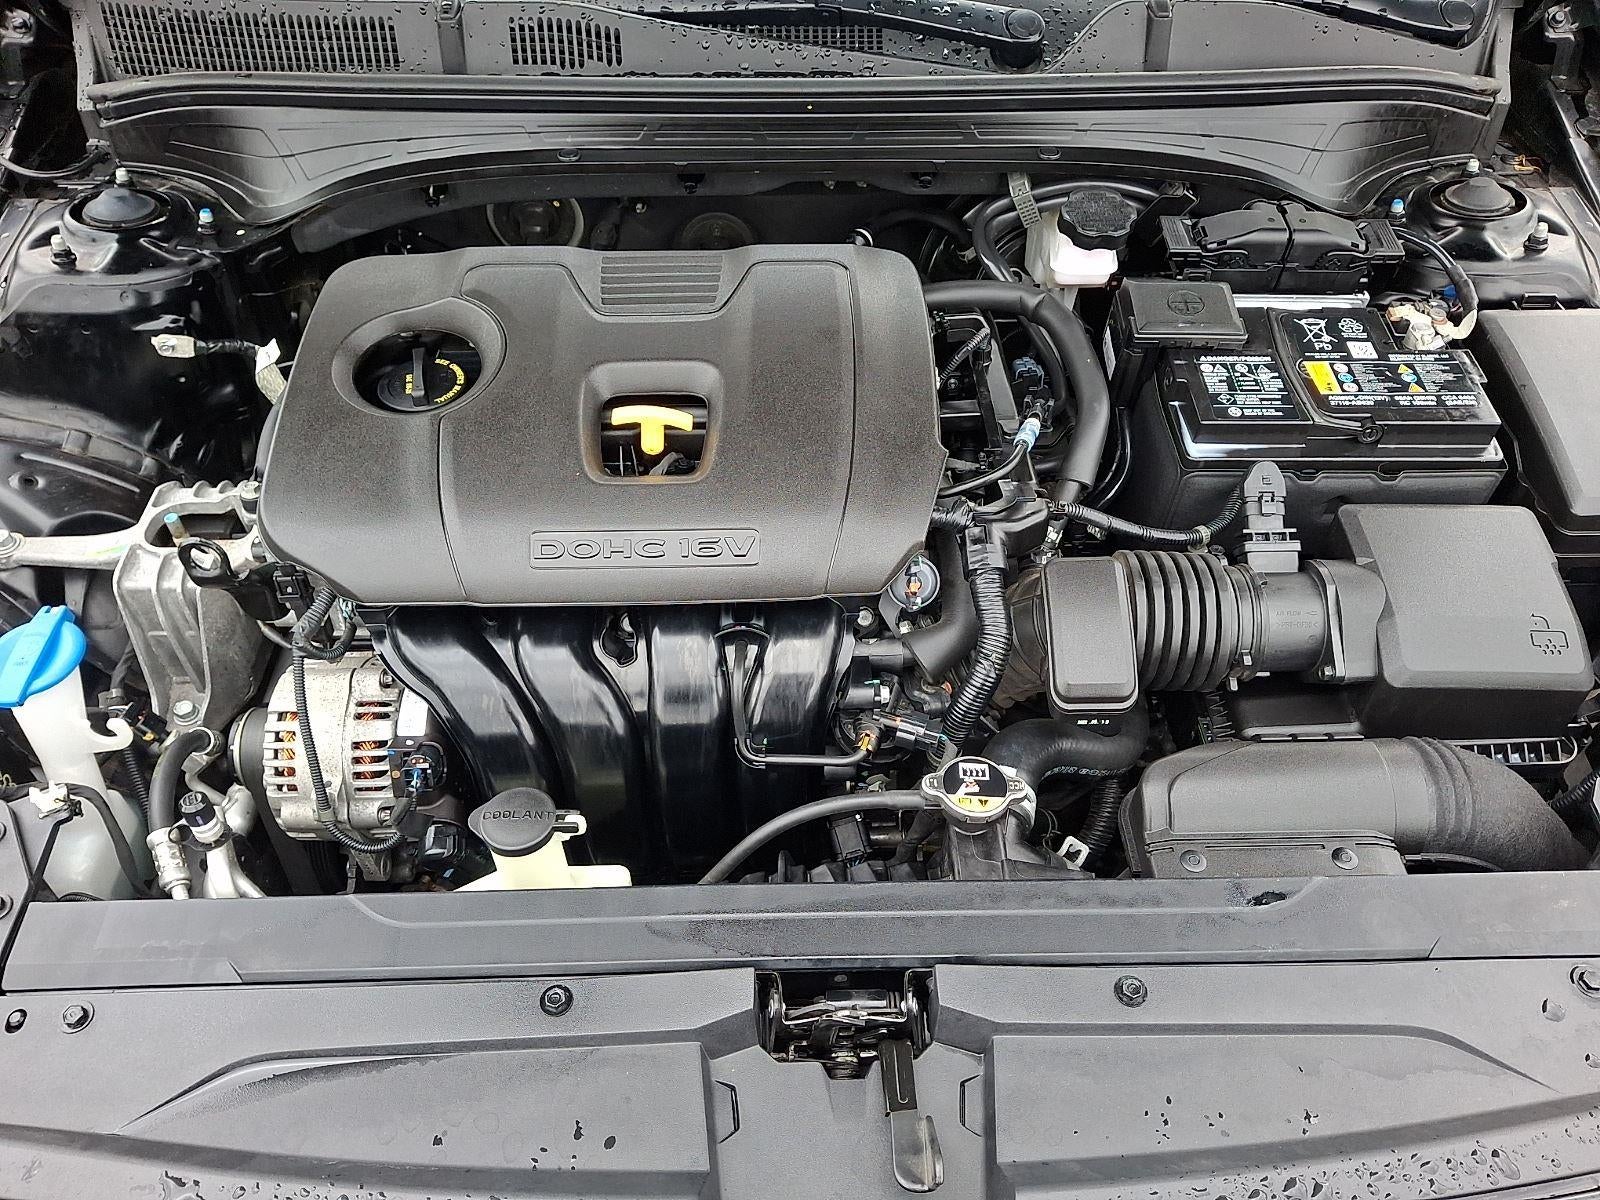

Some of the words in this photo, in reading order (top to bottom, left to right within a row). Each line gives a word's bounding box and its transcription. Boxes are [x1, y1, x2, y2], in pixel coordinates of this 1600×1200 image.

[1314, 342, 1332, 350] Pb
[433, 385, 462, 403] MANUAL
[533, 538, 666, 560] DOHC
[678, 536, 756, 558] 16V
[482, 810, 554, 820] COOLANT
